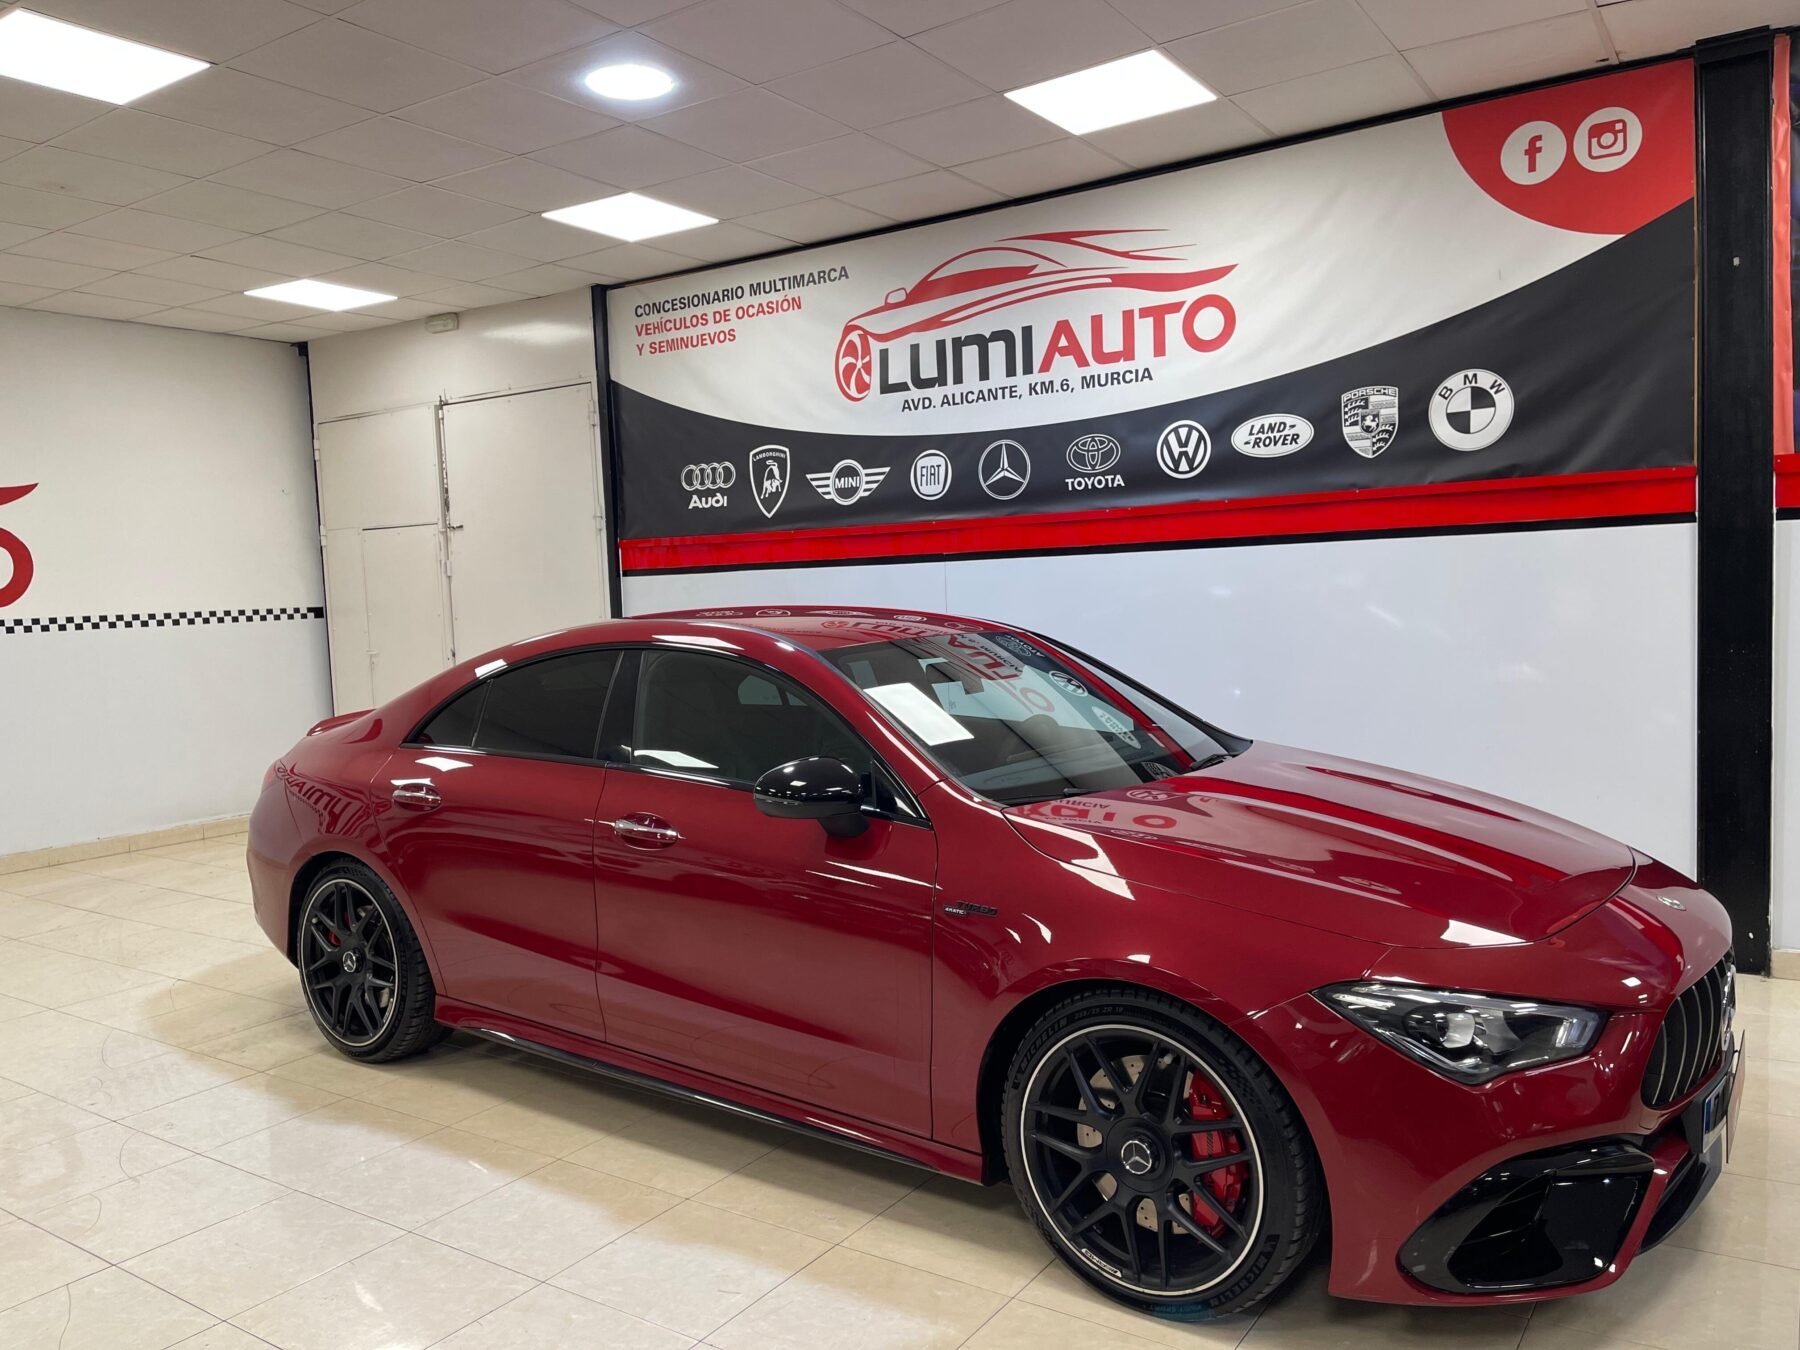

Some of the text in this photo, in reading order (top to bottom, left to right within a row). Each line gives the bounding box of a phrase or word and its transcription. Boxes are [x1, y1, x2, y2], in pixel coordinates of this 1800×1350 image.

[634, 265, 850, 318] CONCESIONARIO MULTIMARCA
[635, 294, 803, 337] VEHÍCULOS DE OCASIÓN
[636, 328, 737, 356] Y SEMINUEVOS
[901, 367, 1153, 413] AVD. ALICANTE, KM.6, MURCIA
[1343, 387, 1398, 403] PORSCHE
[1247, 423, 1288, 438] LAND
[1252, 433, 1300, 448] ROVER
[834, 476, 860, 489] MINI
[919, 463, 942, 487] FIAT
[1065, 474, 1125, 491] TOYOTA
[688, 493, 728, 509] Audi
[1208, 1253, 1268, 1308] MICHELIN
